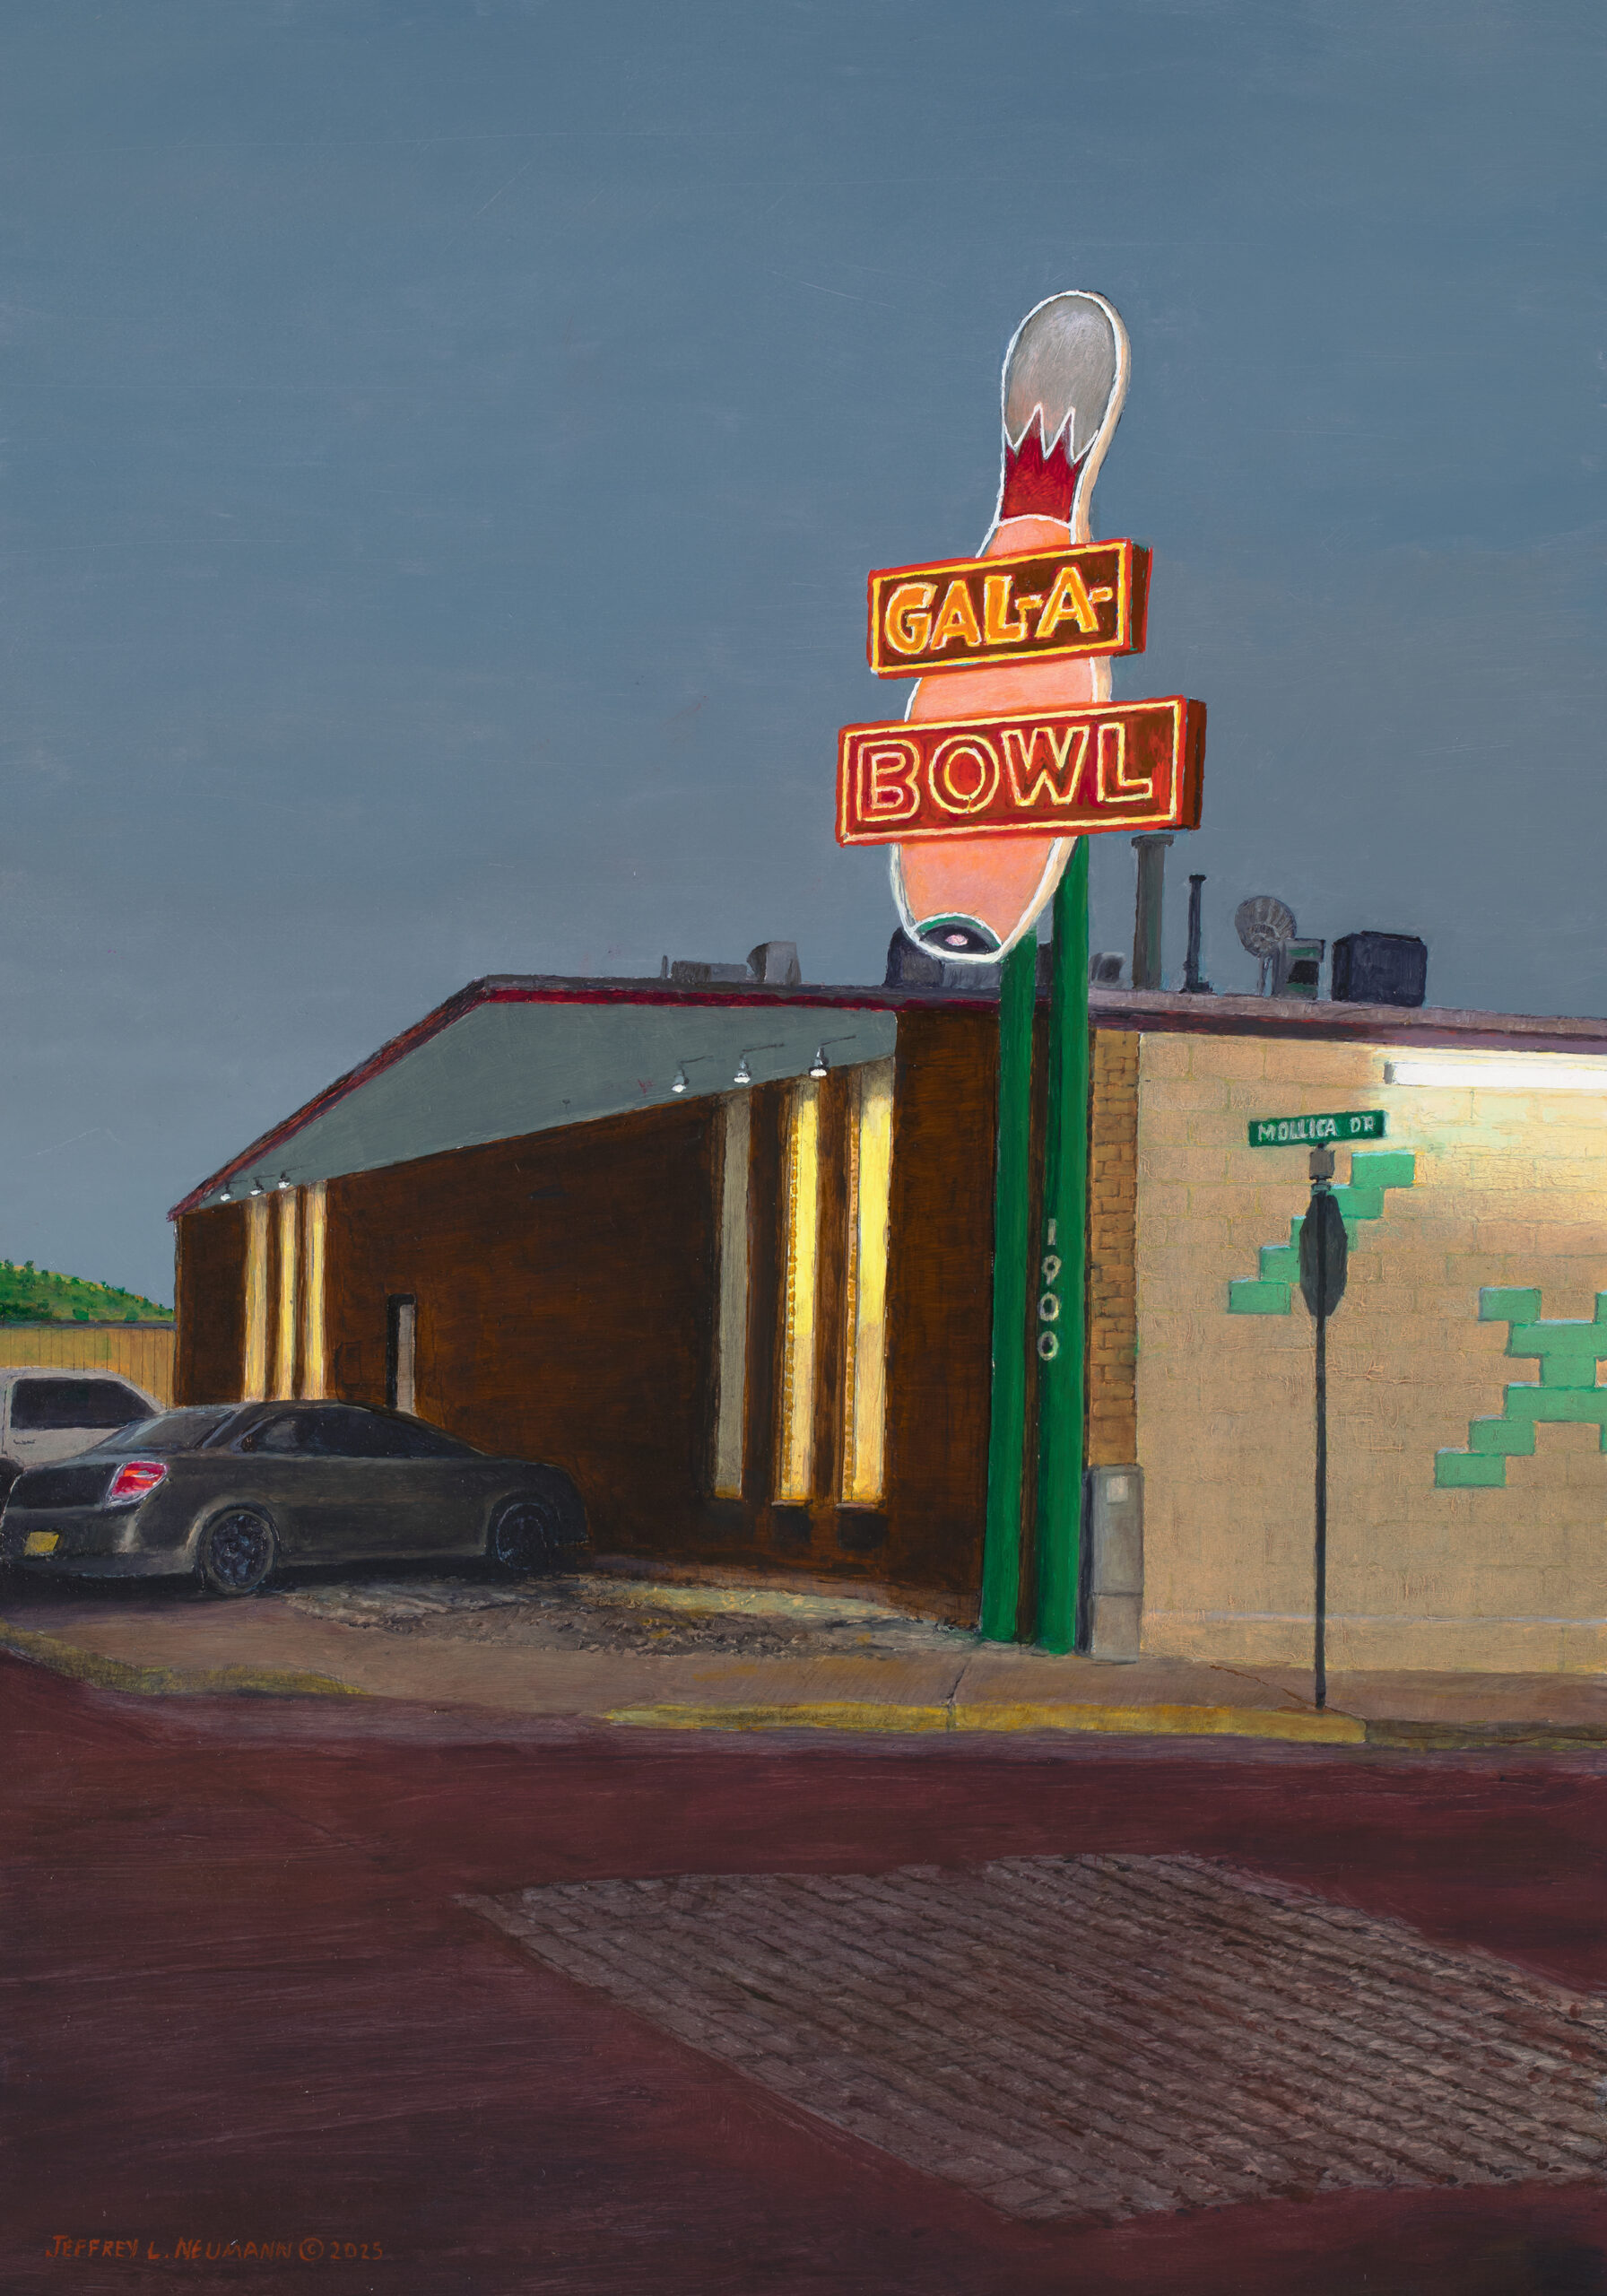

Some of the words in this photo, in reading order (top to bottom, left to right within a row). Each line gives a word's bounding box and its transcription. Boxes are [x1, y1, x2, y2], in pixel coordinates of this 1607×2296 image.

[883, 567, 1113, 656] GAL-A-
[856, 723, 1153, 822] BOWL
[1257, 1118, 1337, 1142] MOLLICA
[1350, 1116, 1375, 1135] DR
[1037, 1218, 1062, 1361] 1900
[46, 2235, 139, 2259] JEFFREY
[148, 2240, 169, 2260] L.
[174, 2237, 293, 2260] NEUMANN
